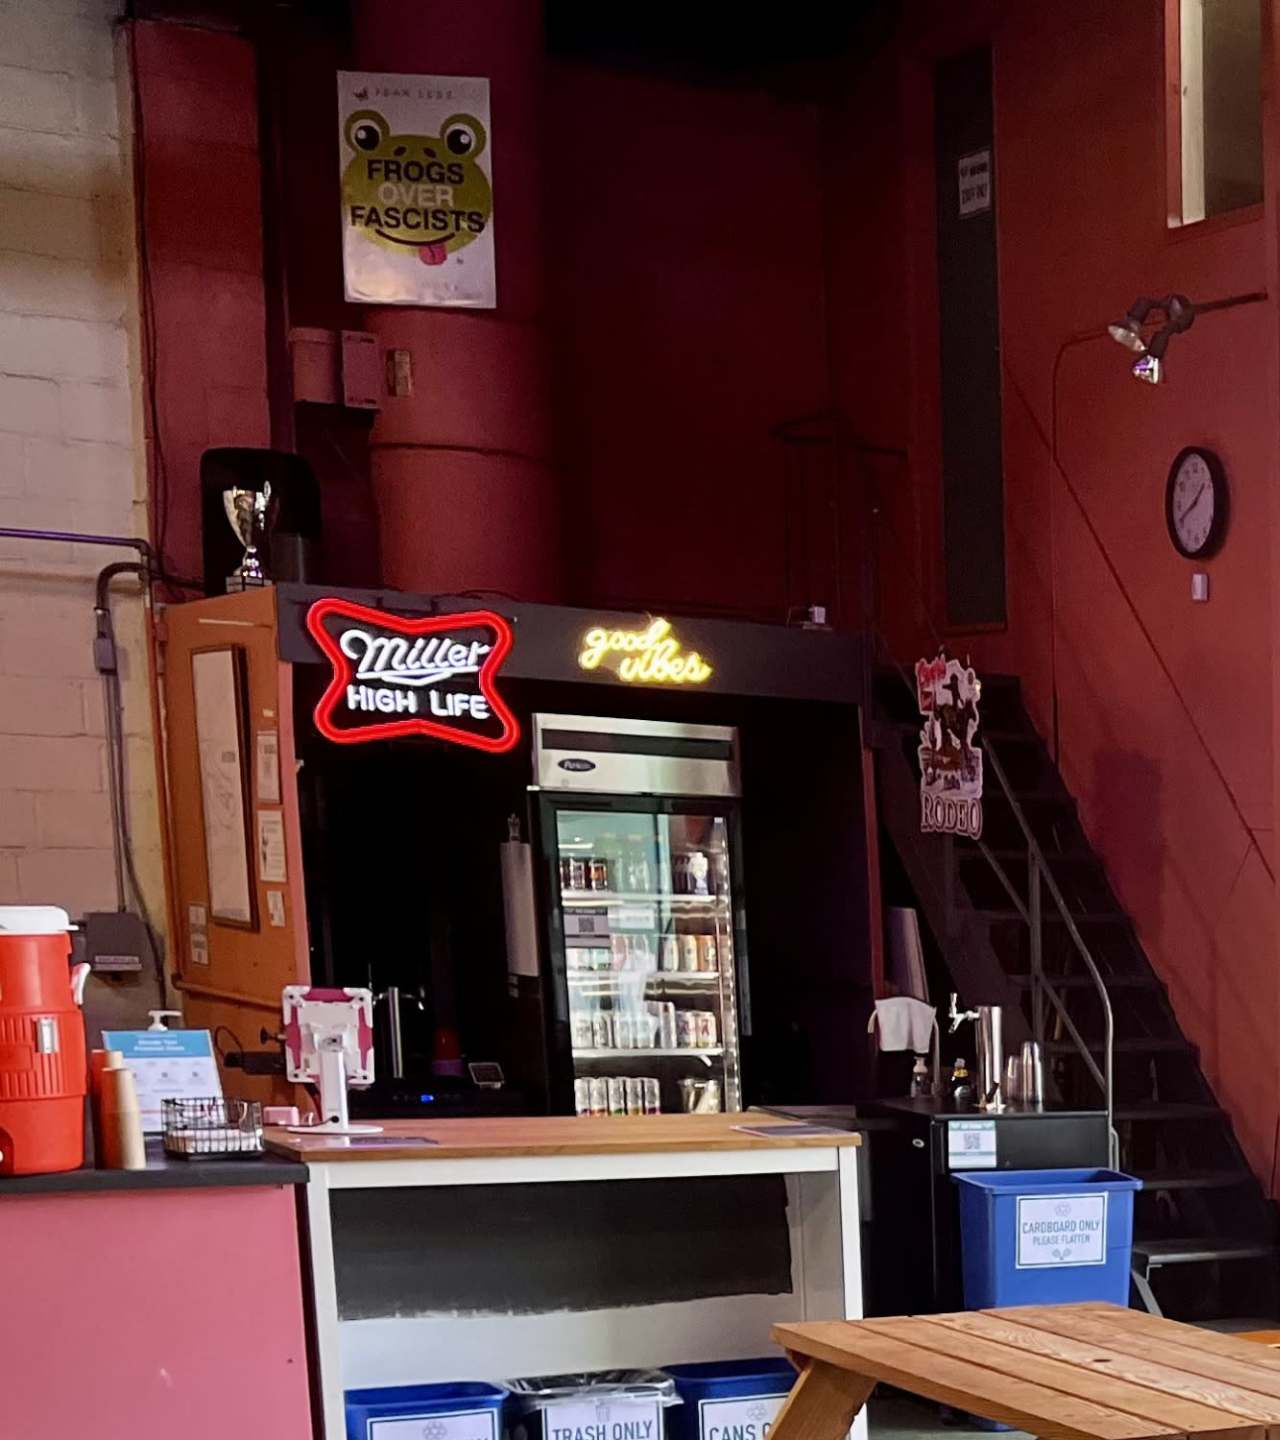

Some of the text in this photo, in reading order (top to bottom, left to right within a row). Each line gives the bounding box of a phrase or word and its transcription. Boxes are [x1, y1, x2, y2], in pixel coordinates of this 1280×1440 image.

[367, 159, 464, 185] FROGS
[378, 183, 454, 207] OVER
[350, 206, 486, 233] FASCISTS
[340, 629, 493, 674] Miller
[578, 617, 671, 670] good
[619, 637, 713, 683] vibes
[346, 684, 491, 720] HIGH LIFE
[921, 792, 983, 840] RODEO
[1022, 1219, 1100, 1234] CARDBOARD ONLY
[1033, 1235, 1058, 1246] PLEASE
